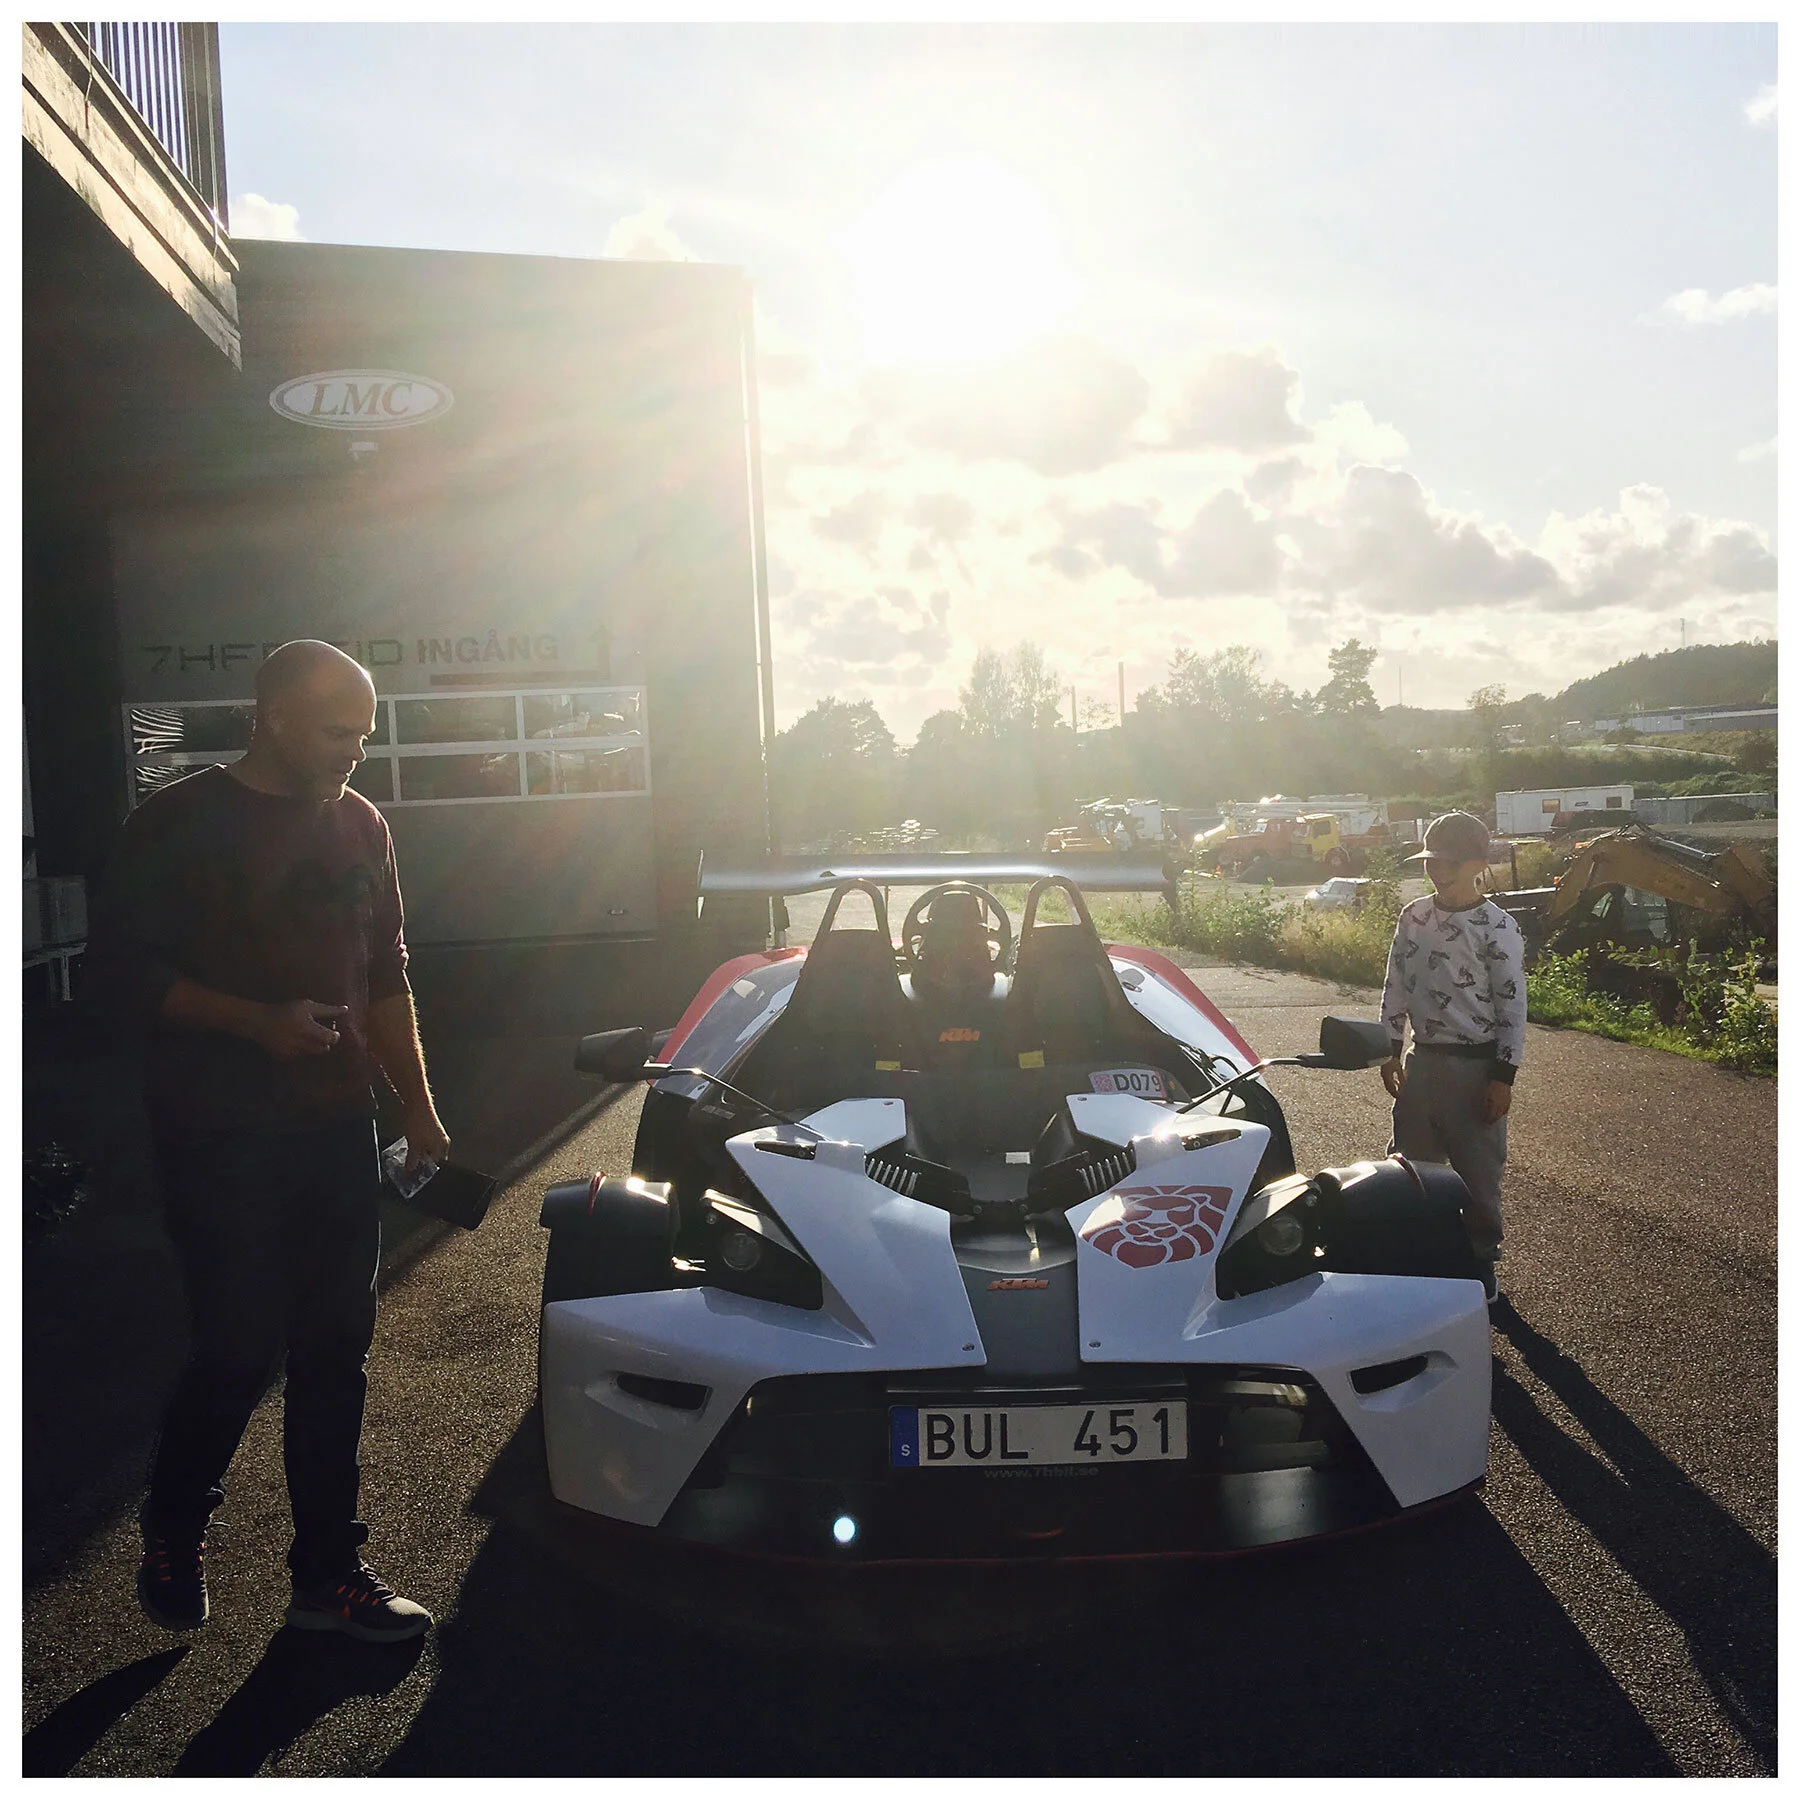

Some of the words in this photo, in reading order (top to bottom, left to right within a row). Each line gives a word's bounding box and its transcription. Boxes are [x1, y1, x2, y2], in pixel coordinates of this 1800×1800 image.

[309, 382, 413, 416] LMC
[417, 628, 559, 664] INGÅNG
[939, 1028, 980, 1042] KTM
[1112, 1073, 1161, 1092] D079
[986, 1278, 1049, 1290] KTM
[901, 1444, 911, 1457] S
[926, 1413, 1029, 1461] BUL
[1073, 1407, 1169, 1457] 451
